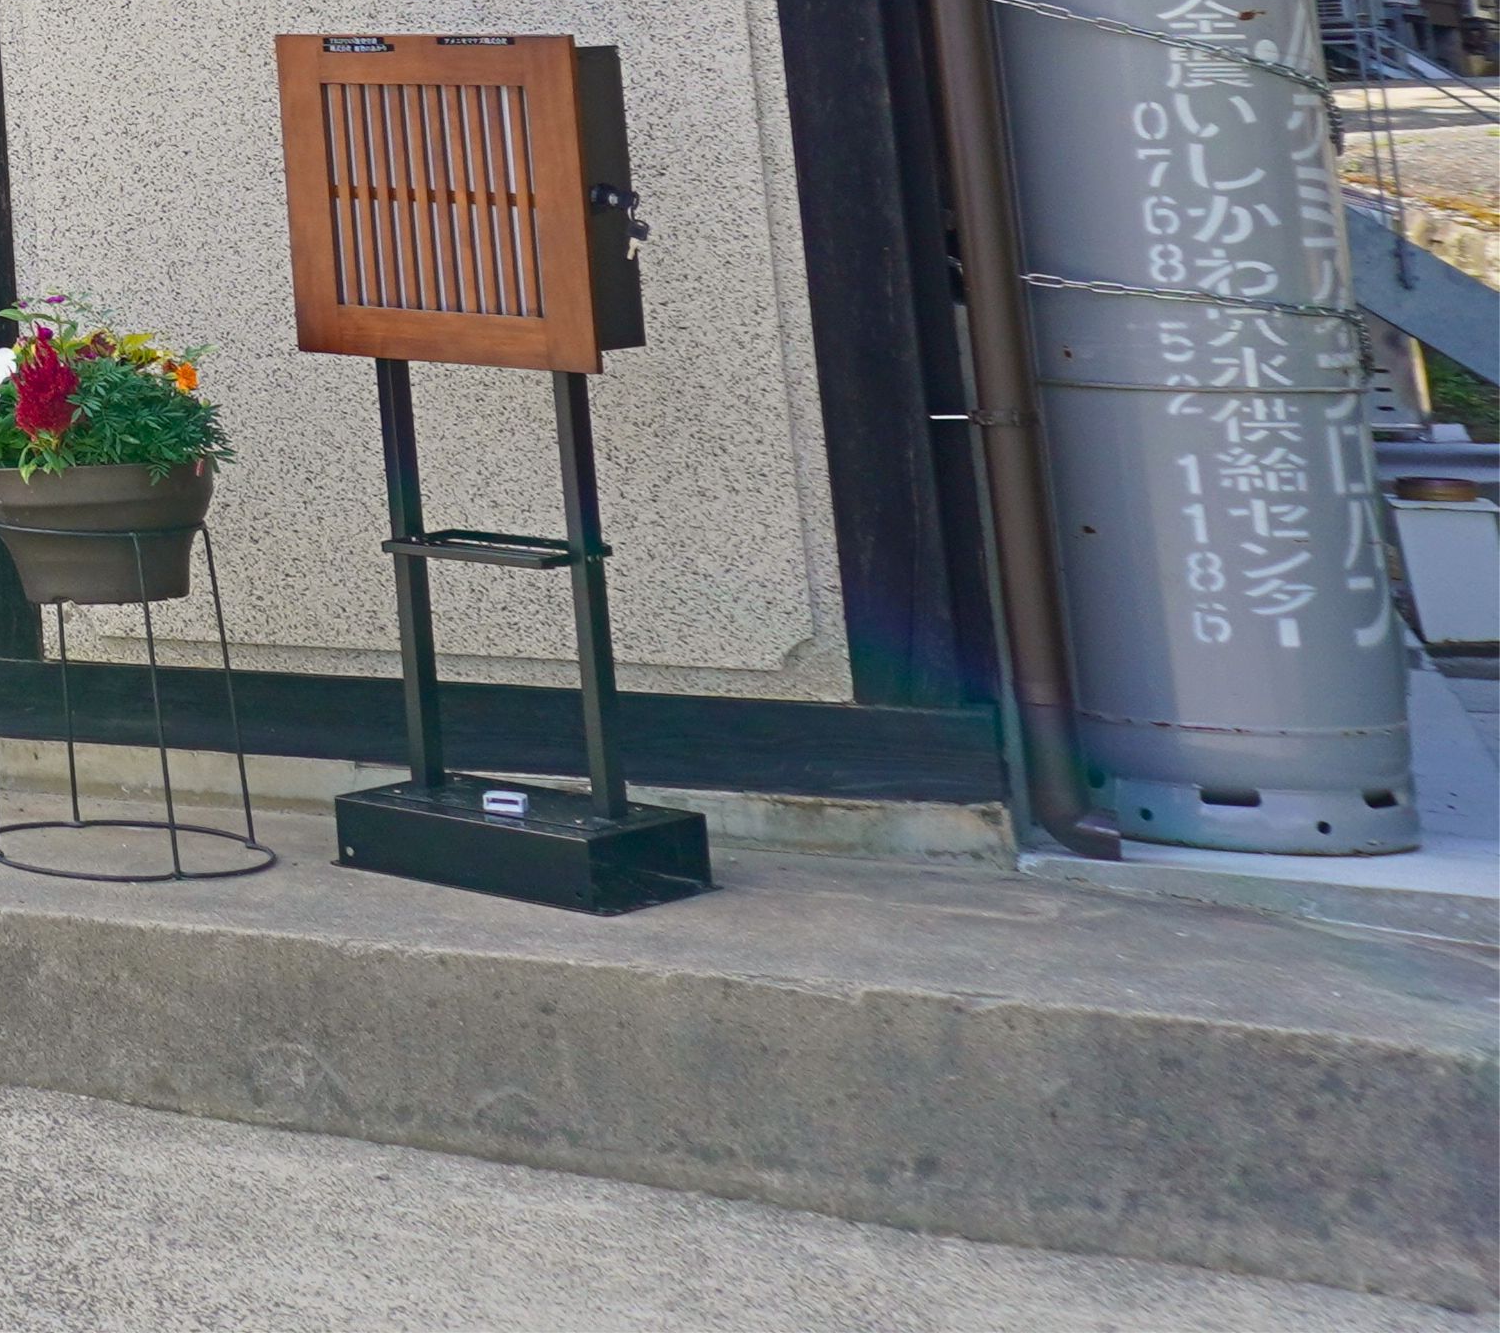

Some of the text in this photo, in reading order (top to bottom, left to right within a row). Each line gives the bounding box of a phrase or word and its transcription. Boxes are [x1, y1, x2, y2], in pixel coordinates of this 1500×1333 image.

[1133, 100, 1233, 646] 0768 52 1186
